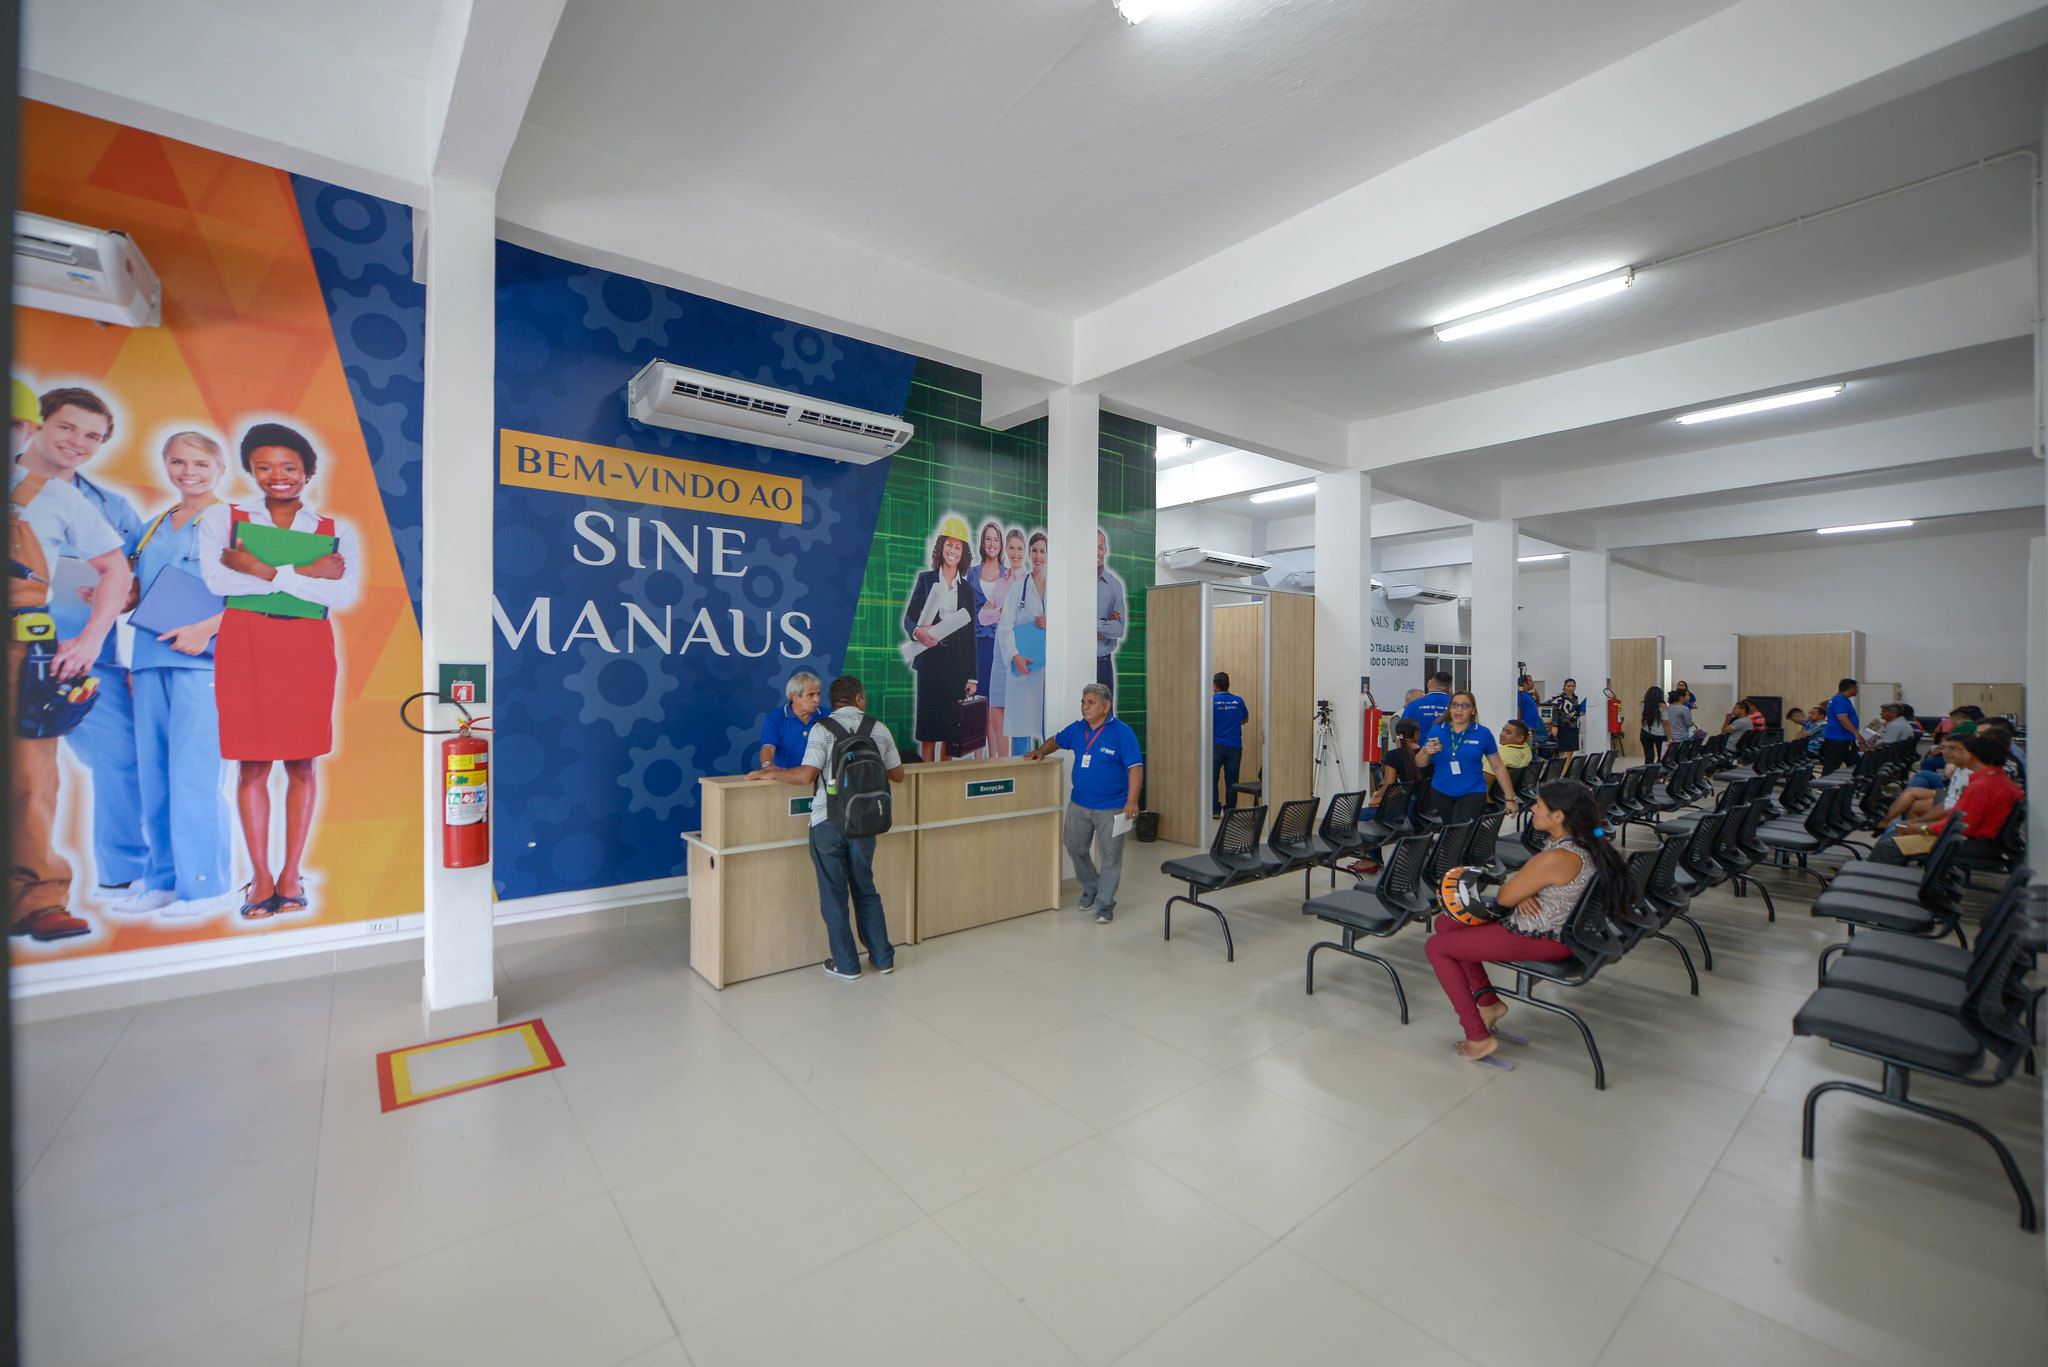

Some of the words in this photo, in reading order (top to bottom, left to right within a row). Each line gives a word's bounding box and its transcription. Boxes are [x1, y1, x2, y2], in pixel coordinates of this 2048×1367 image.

[514, 445, 741, 503] BEM-VINDO
[749, 484, 793, 512] AO
[573, 510, 748, 578] SINE
[491, 594, 813, 660] MANAUS
[1375, 643, 1404, 653] TRABALHO
[1405, 645, 1409, 653] E
[1382, 658, 1386, 666] O
[1387, 658, 1409, 667] FUTURO
[980, 784, 1004, 792] Recepção
